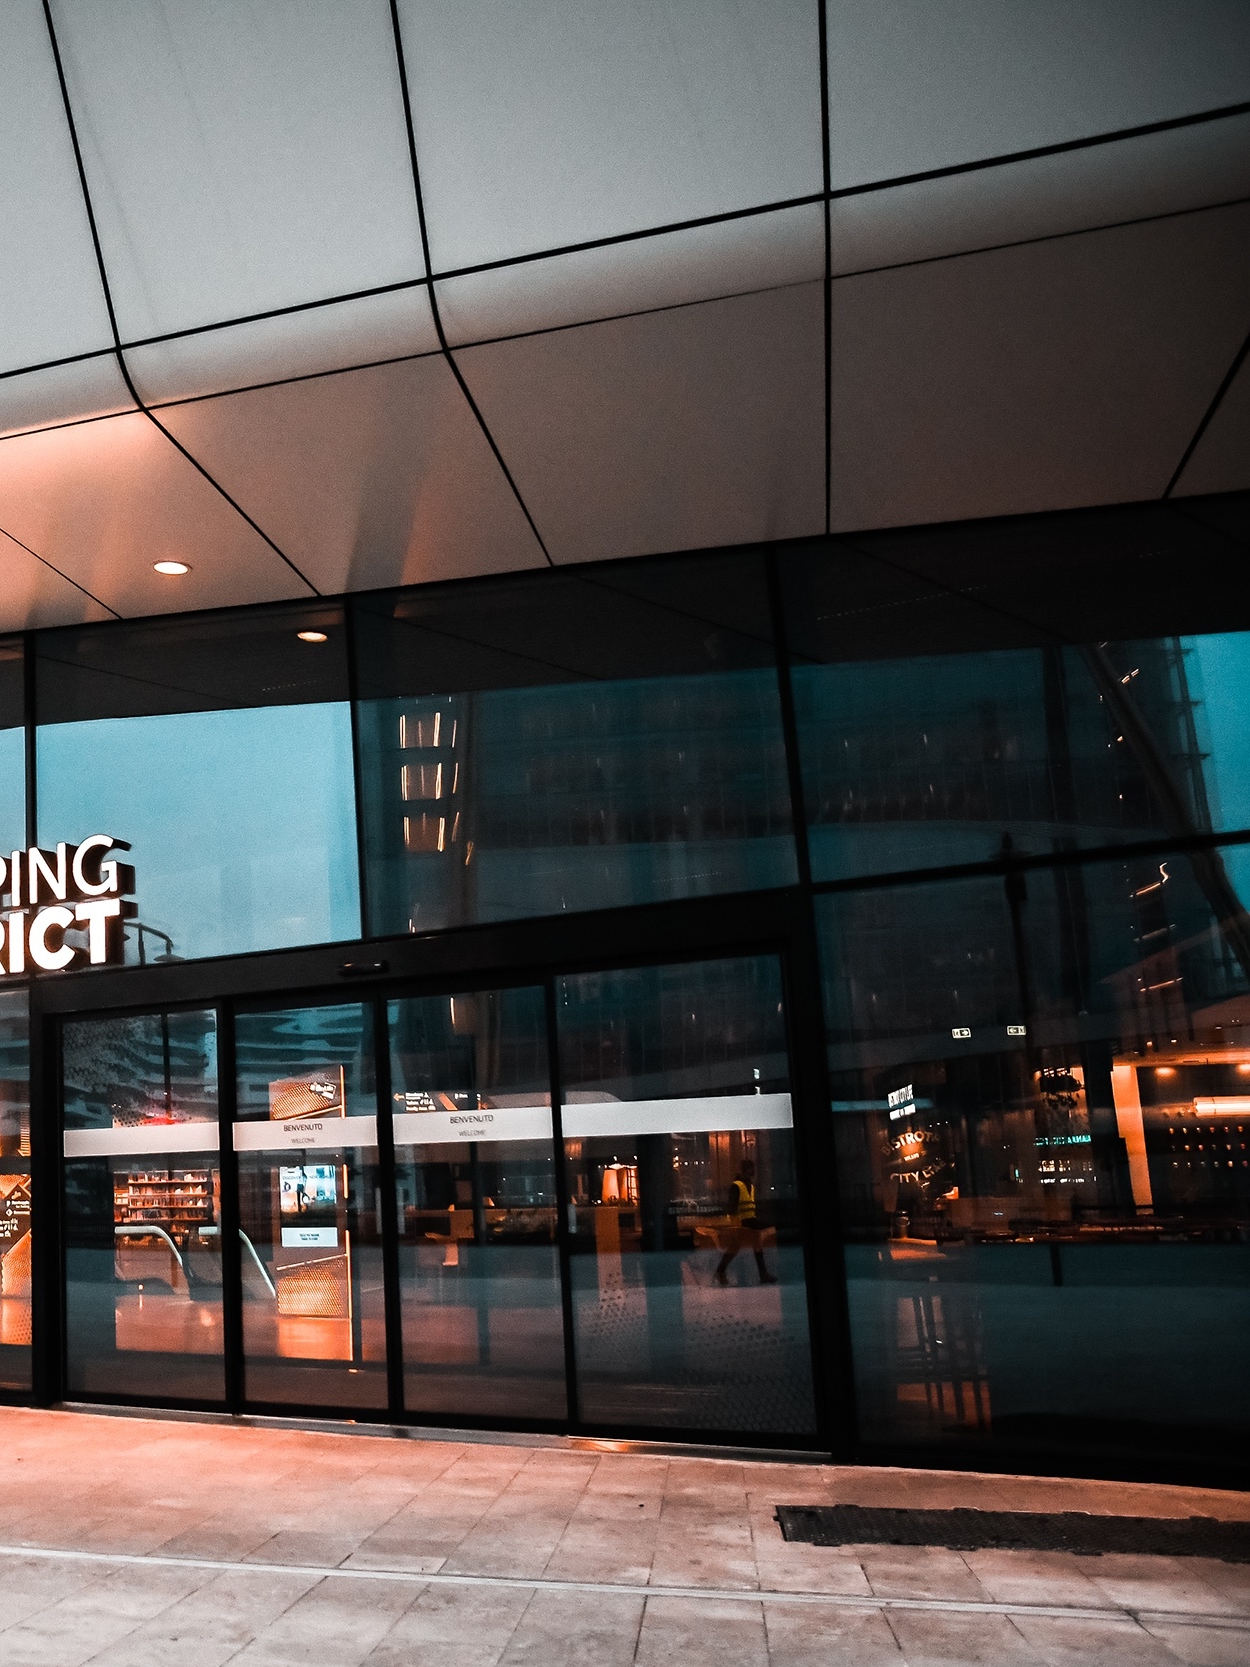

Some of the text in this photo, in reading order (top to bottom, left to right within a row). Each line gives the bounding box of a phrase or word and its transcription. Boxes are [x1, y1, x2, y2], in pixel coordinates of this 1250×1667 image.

[450, 1114, 494, 1125] BENVENUTO
[283, 1123, 323, 1132] BENVENUTO
[458, 1129, 487, 1137] WELCOME
